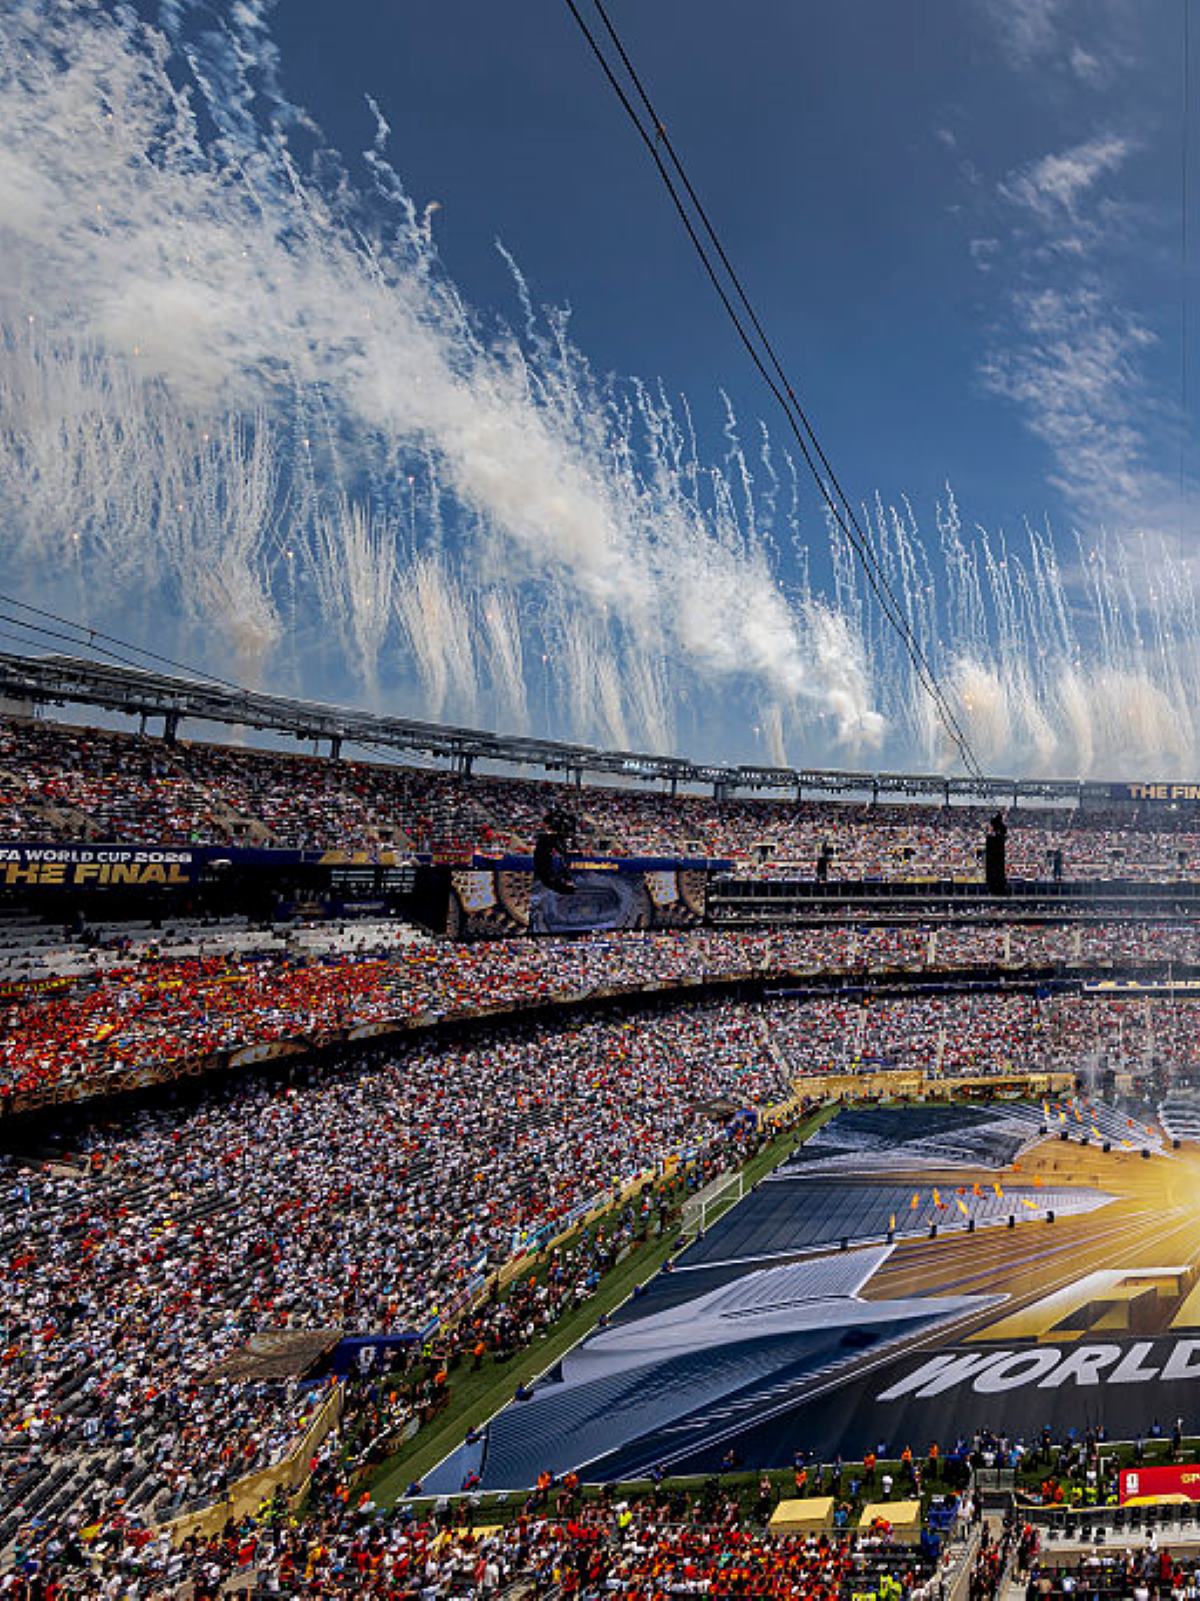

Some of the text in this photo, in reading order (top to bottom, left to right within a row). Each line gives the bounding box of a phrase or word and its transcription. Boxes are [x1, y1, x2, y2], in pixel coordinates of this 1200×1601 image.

[1127, 785, 1166, 799] THE
[25, 850, 93, 862] WORLD
[97, 851, 131, 863] CUP
[73, 863, 190, 883] FINAL
